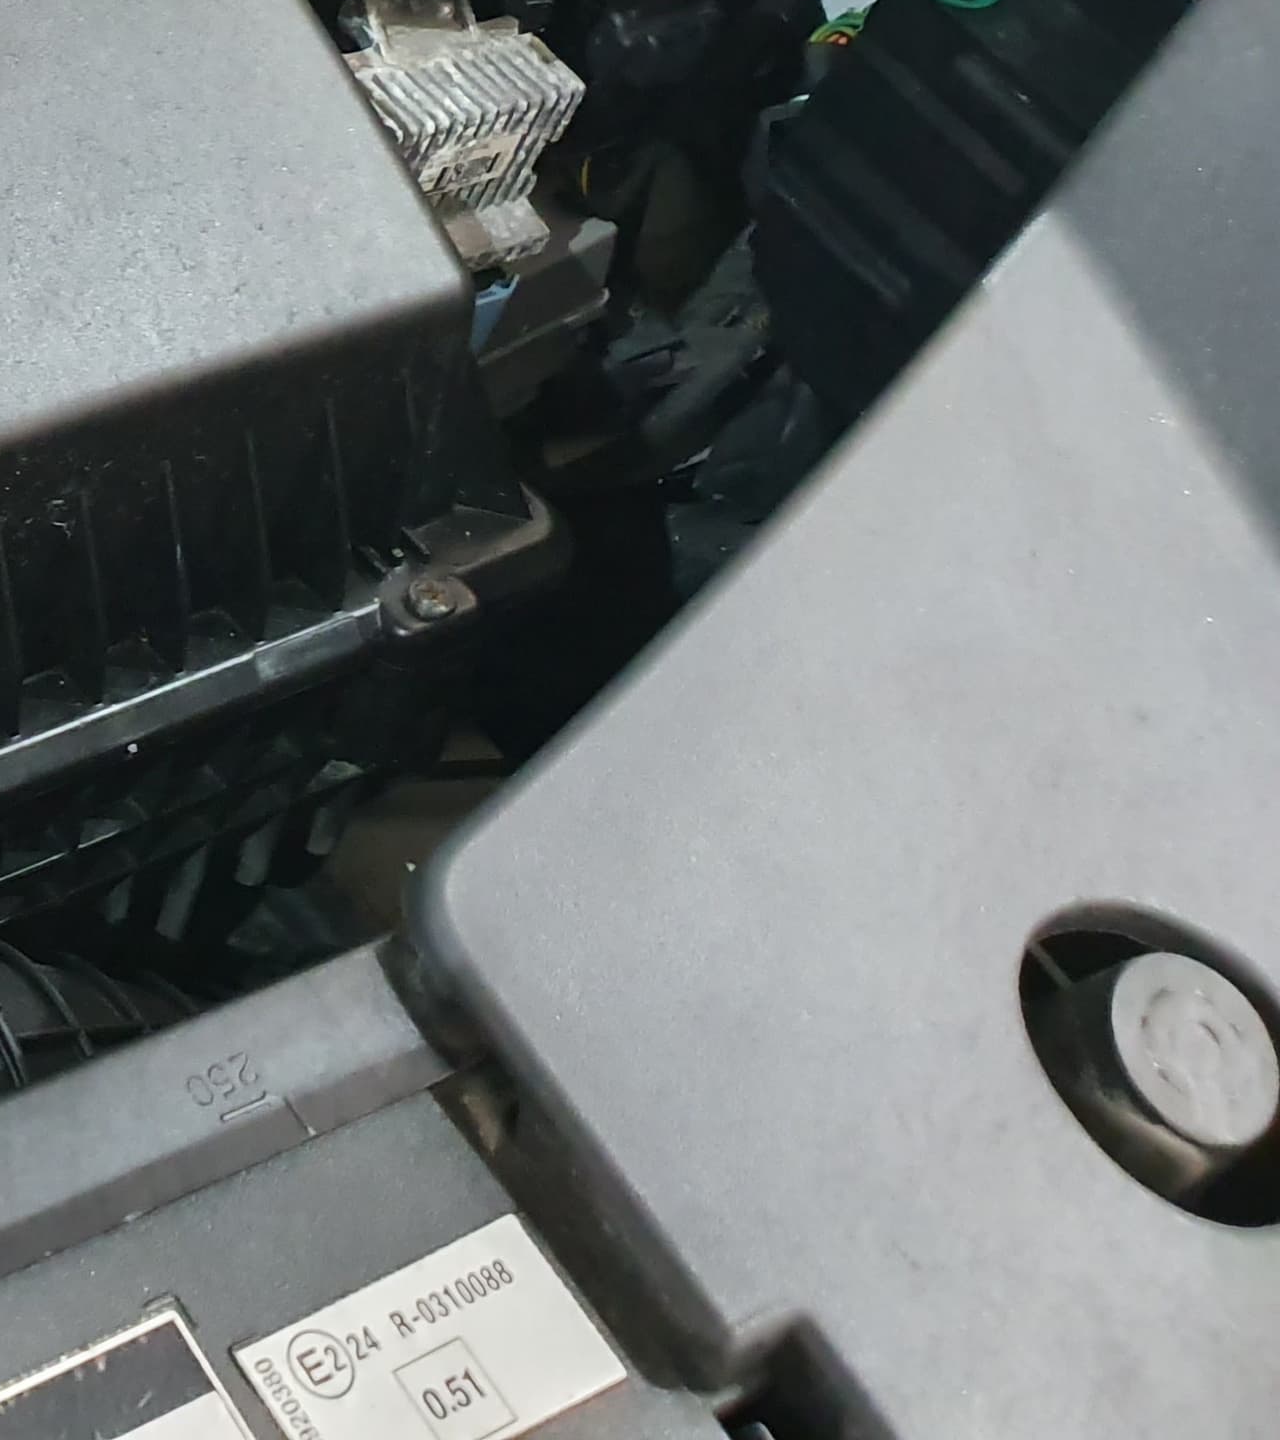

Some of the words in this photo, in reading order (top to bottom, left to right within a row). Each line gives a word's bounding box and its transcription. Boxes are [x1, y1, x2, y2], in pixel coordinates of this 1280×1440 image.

[346, 1326, 381, 1360] 24
[389, 1259, 513, 1338] R-0310088
[422, 1367, 488, 1421] 0.51
